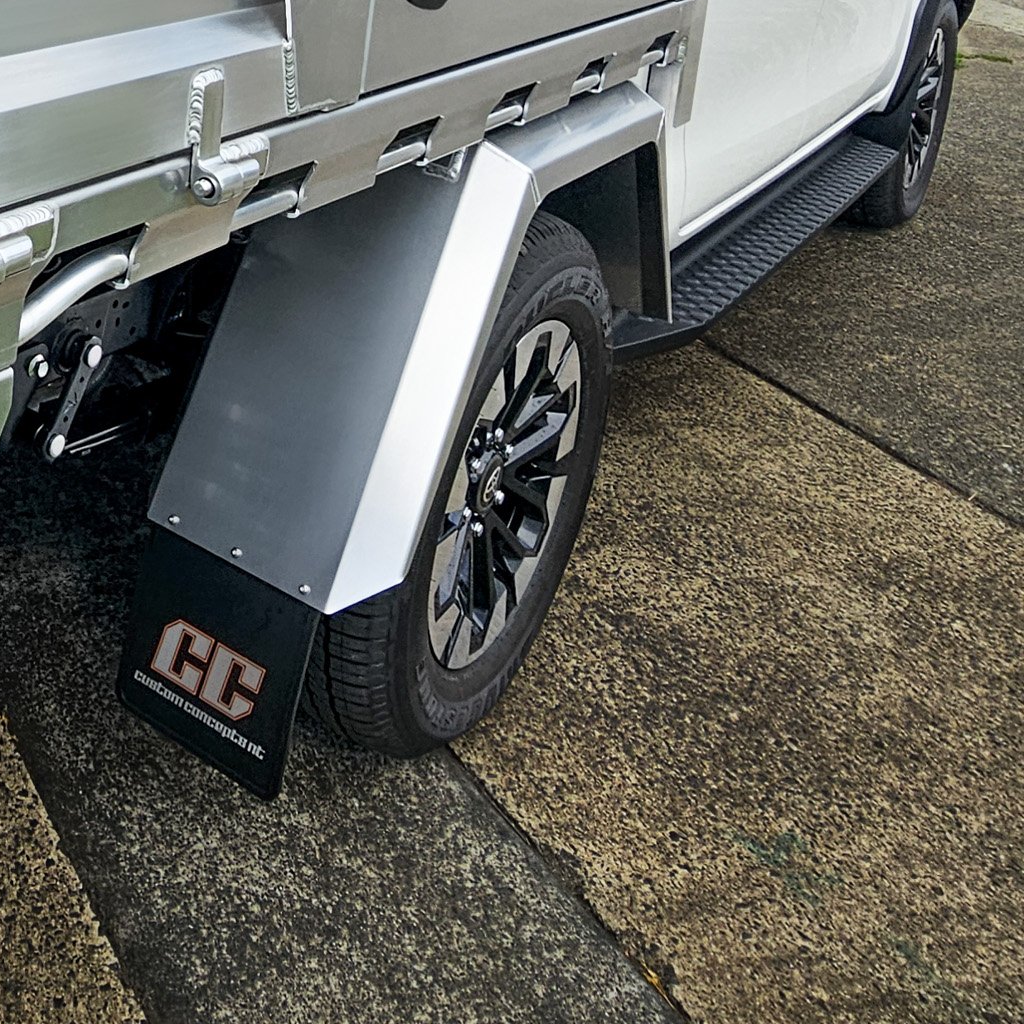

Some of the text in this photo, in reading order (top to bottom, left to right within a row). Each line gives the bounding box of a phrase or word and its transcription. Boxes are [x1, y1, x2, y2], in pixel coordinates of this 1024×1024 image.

[134, 669, 184, 707] custom
[184, 701, 247, 749] concepts
[150, 618, 267, 721] CC
